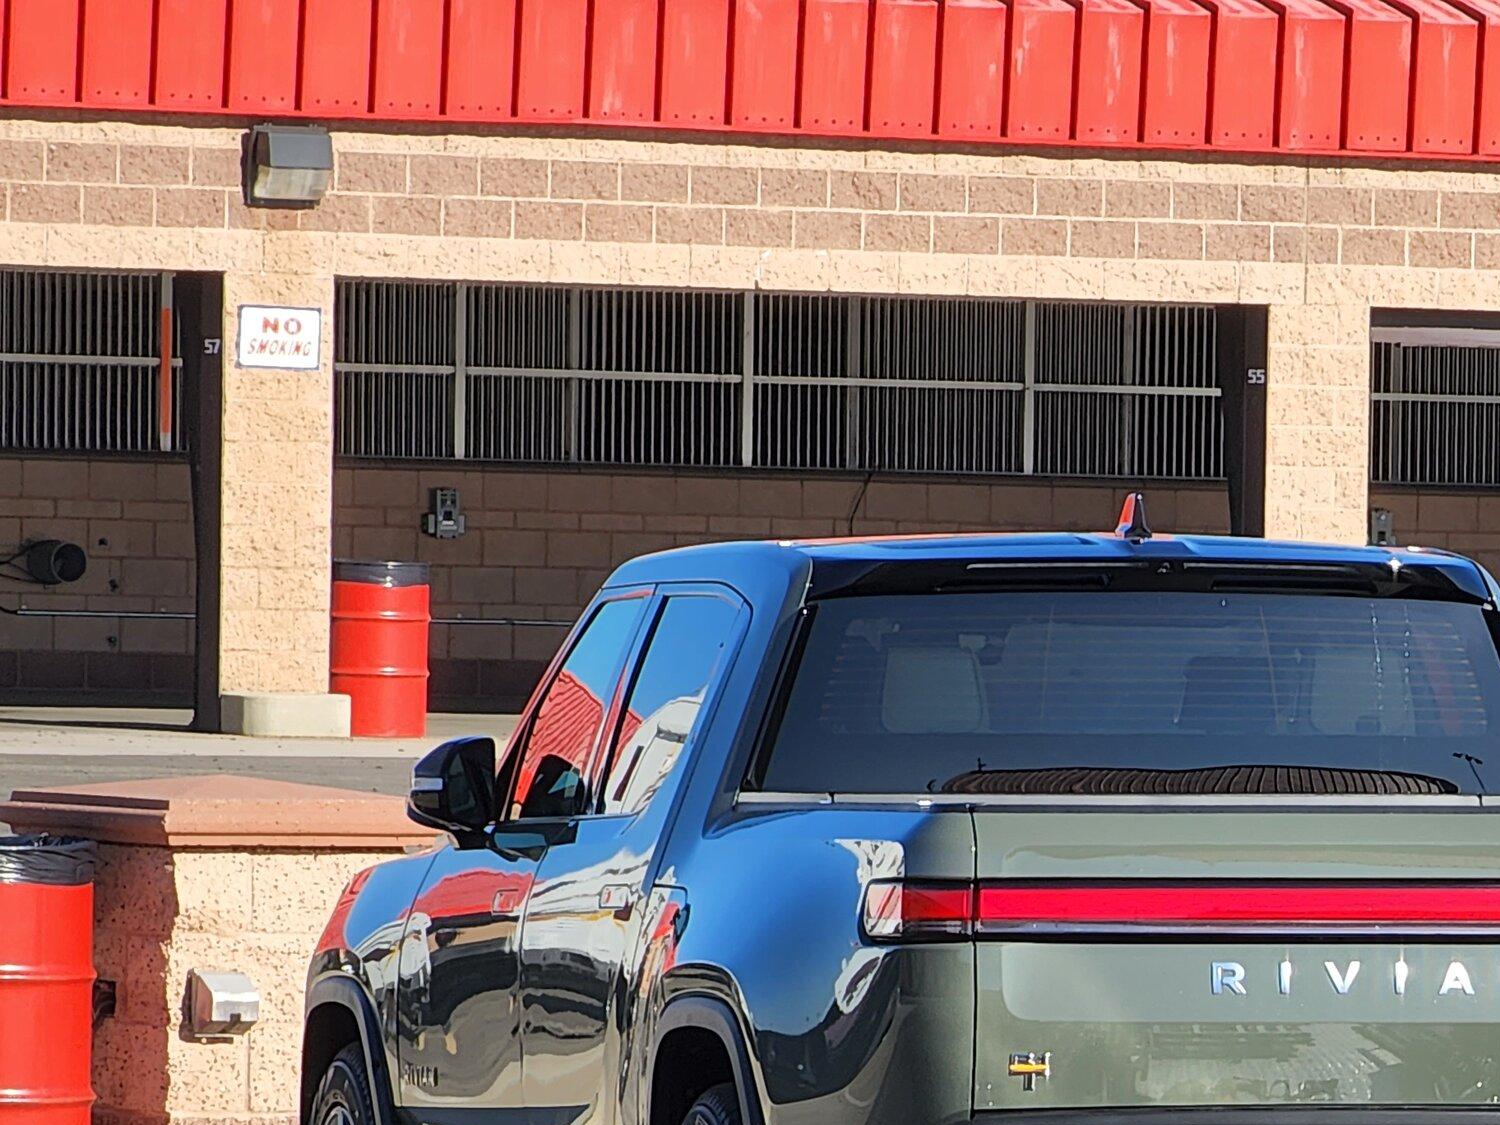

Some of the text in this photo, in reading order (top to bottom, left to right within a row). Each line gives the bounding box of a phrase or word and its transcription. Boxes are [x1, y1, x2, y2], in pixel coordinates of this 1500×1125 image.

[262, 317, 302, 335] NO
[203, 338, 220, 354] 57
[247, 338, 312, 356] SMOKING
[1247, 368, 1265, 384] 55
